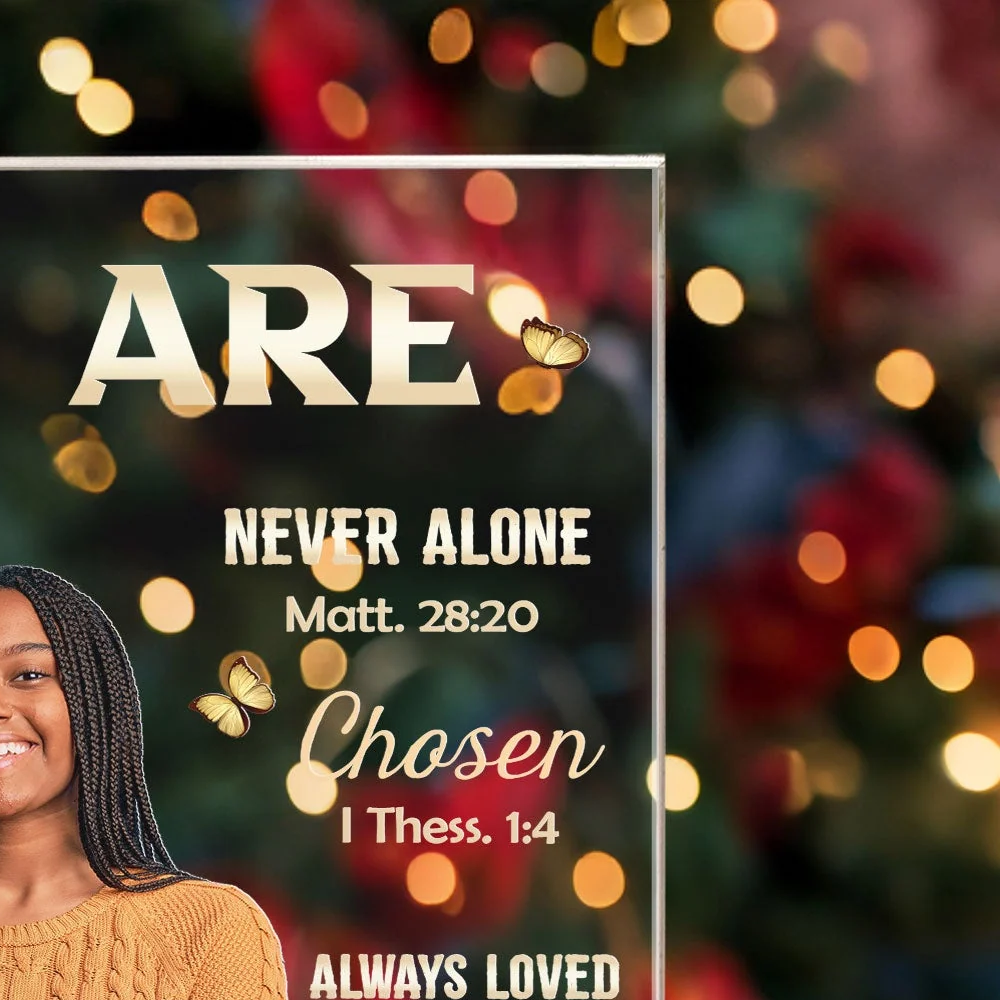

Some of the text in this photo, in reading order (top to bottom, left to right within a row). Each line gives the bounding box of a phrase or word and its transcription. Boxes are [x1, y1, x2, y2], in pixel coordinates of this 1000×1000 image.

[68, 263, 481, 407] ARE
[224, 506, 591, 567] NEVER ALONE
[285, 595, 540, 633] Matt. 28:20
[299, 689, 605, 781] Chosen
[366, 806, 492, 845] Thess.
[505, 809, 560, 845] 1:4
